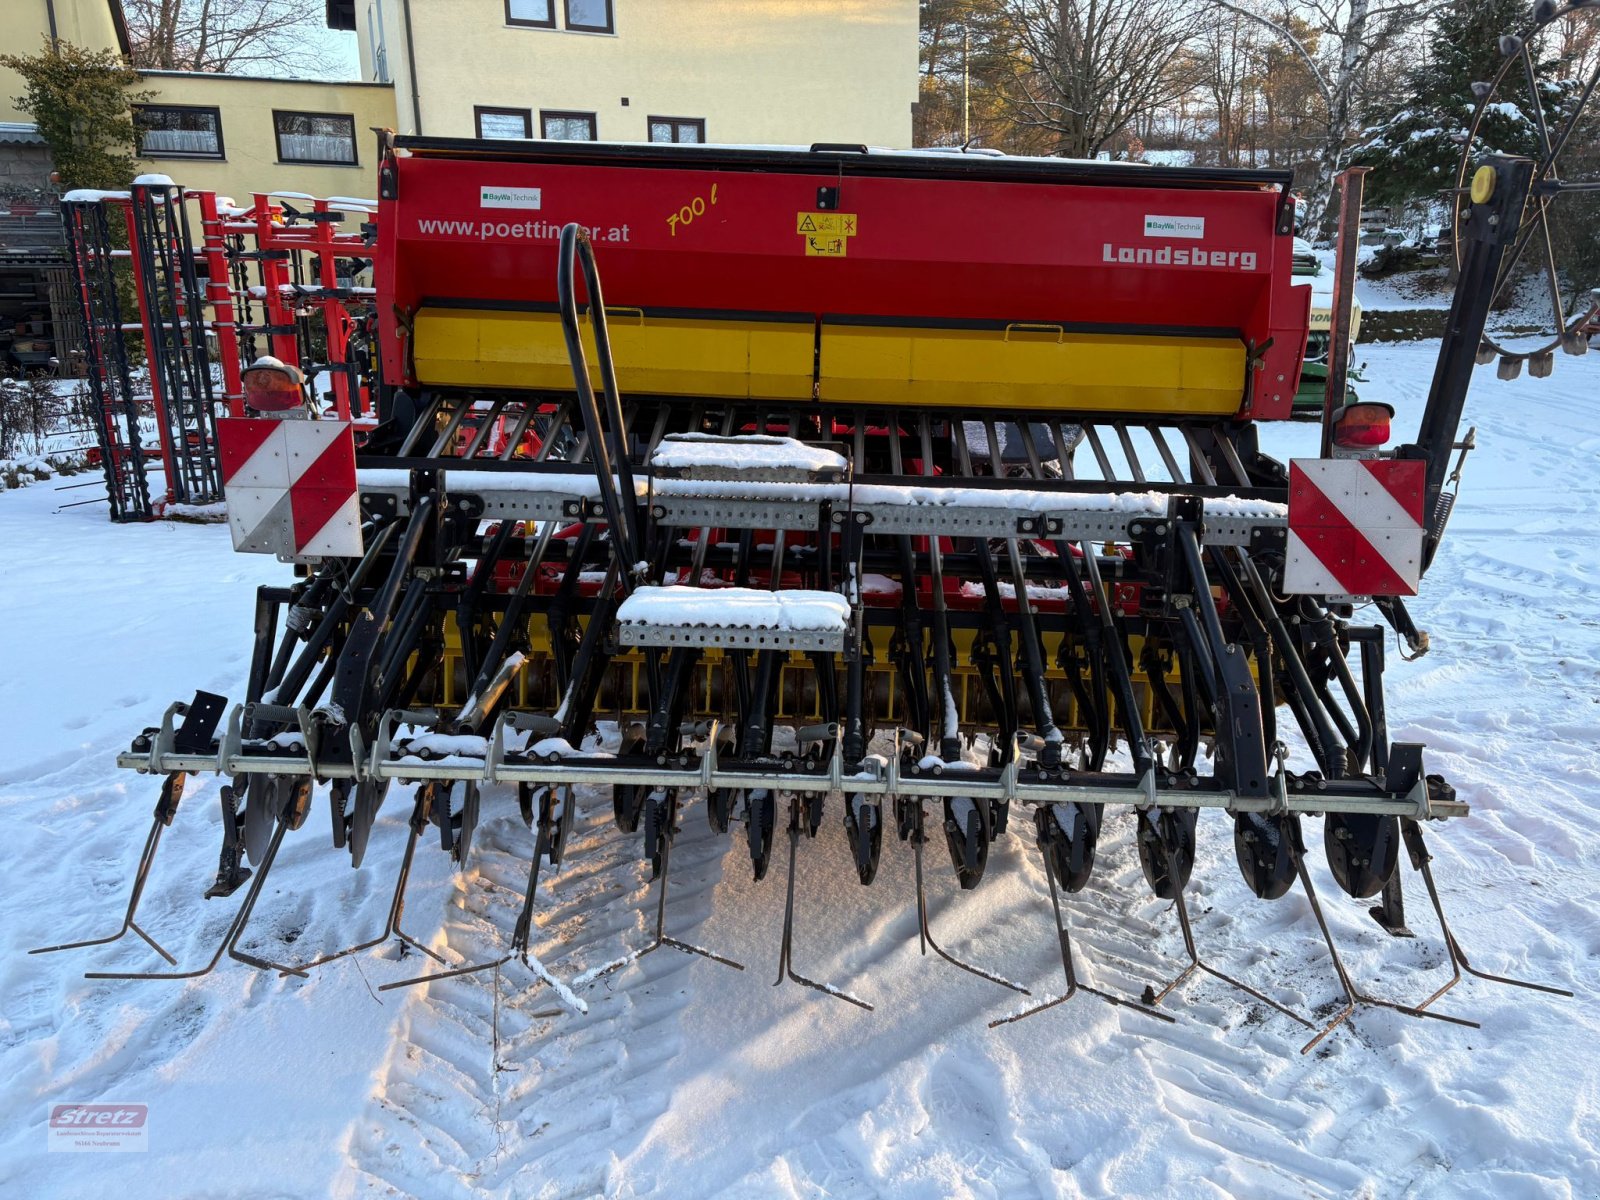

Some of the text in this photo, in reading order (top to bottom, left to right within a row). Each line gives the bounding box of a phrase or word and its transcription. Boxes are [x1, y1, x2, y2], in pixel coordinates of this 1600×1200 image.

[666, 197, 705, 236] 700
[1152, 222, 1202, 231] BayWa Technik
[418, 219, 630, 242] www.poettiner.at
[1103, 243, 1257, 270] Landsberg
